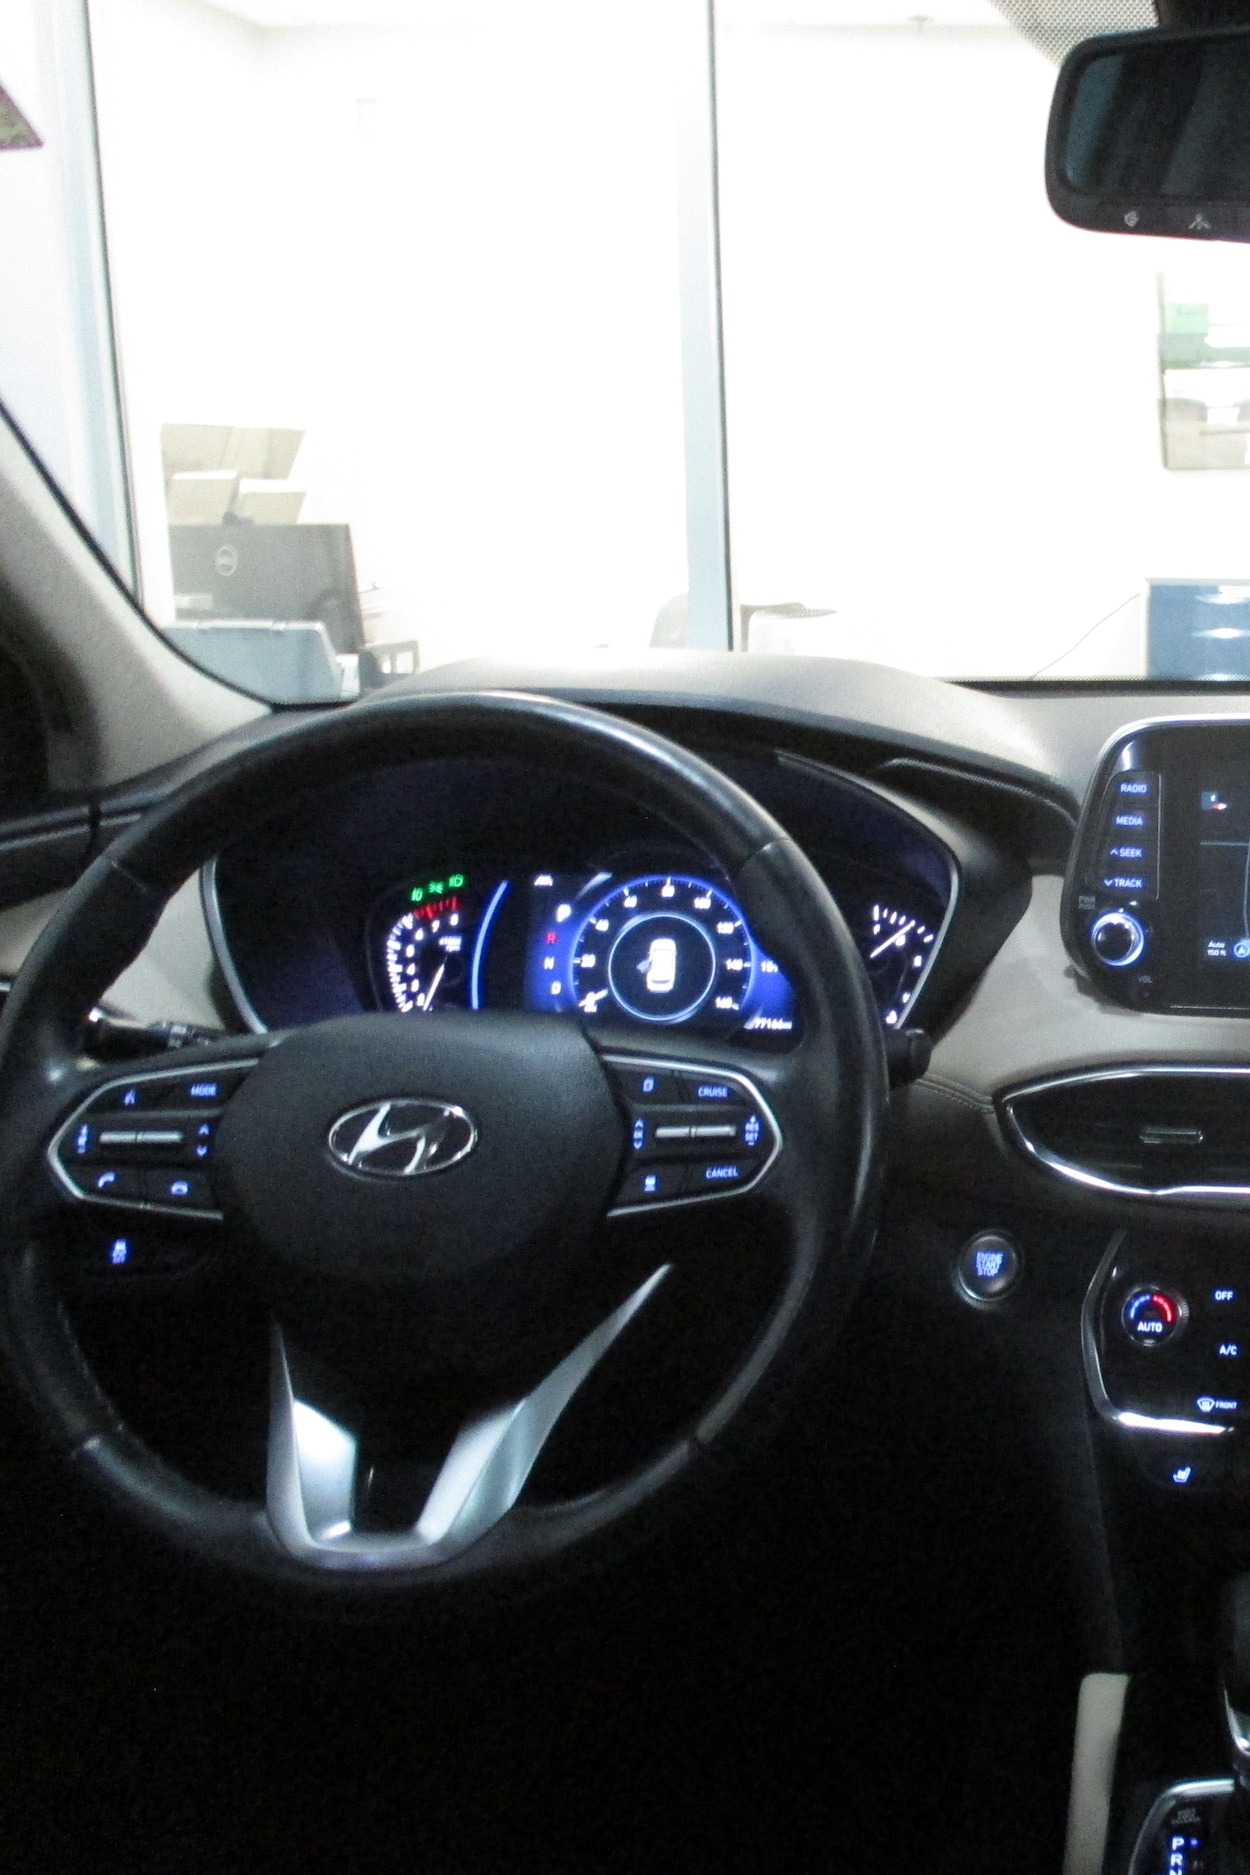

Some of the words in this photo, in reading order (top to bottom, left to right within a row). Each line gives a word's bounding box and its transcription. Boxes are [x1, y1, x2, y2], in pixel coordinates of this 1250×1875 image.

[1120, 784, 1147, 793] RADIO
[1116, 816, 1143, 826] MEDIA
[1119, 848, 1142, 858] SEEK
[1114, 879, 1143, 889] TRACK
[190, 1083, 218, 1096] MODE
[698, 1086, 728, 1098] CRUISE
[744, 1132, 759, 1142] SET
[706, 1166, 739, 1179] CANCEL
[976, 1260, 1002, 1269] START
[977, 1267, 999, 1277] STOP
[1214, 1290, 1234, 1301] OFF
[1137, 1321, 1163, 1333] AUTO
[1219, 1344, 1238, 1355] A/C
[1215, 1400, 1237, 1409] FRONT
[1172, 1837, 1185, 1851] P
[1170, 1853, 1183, 1867] R
